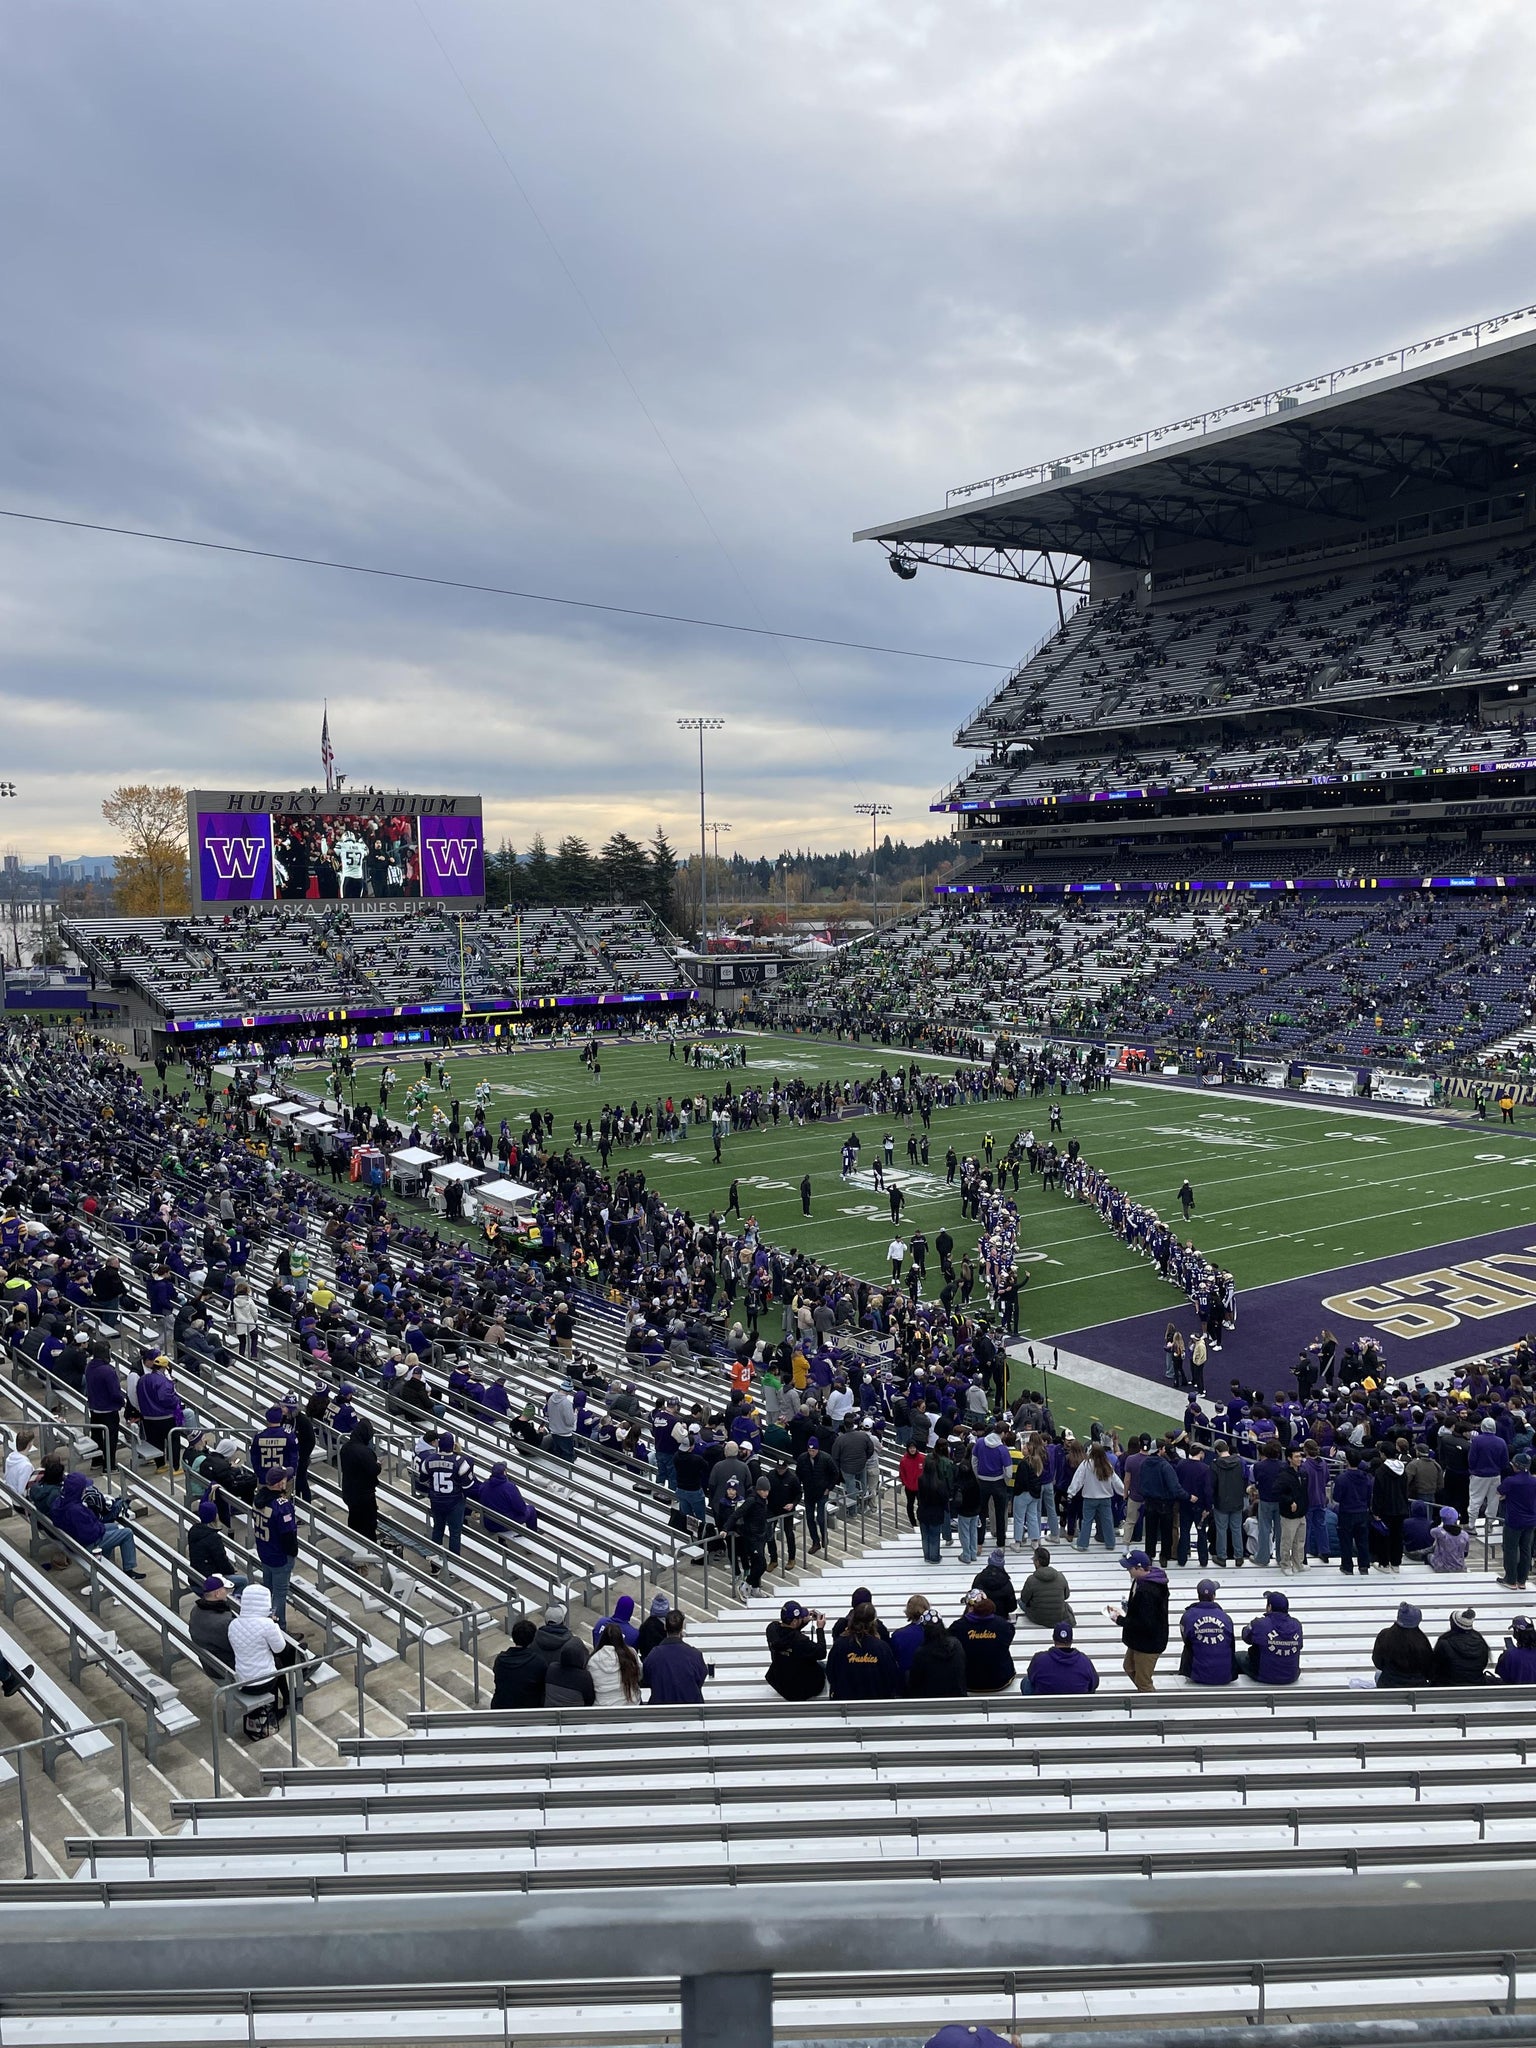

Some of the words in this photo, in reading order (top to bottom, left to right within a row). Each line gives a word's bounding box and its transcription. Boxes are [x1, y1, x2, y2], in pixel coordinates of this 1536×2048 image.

[1495, 761, 1526, 770] WOMEN'S
[226, 794, 324, 812] HUSKY
[338, 797, 456, 814] STADIUM
[1444, 802, 1508, 816] NATIONAL
[205, 838, 265, 878] W
[345, 851, 362, 866] 57
[426, 838, 477, 877] W
[1451, 878, 1476, 886] facebook
[248, 904, 315, 916] ALASKA
[324, 903, 397, 915] AIRLINES
[403, 902, 447, 914] FIELD
[440, 975, 483, 989] Allstate
[740, 967, 759, 983] W
[195, 1020, 222, 1029] facebook
[830, 1336, 840, 1347] W
[878, 1341, 888, 1352] W
[260, 1447, 284, 1468] 25
[432, 1471, 454, 1494] 15
[1193, 1616, 1225, 1630] ALUMNI
[967, 1629, 997, 1640] Huskies
[1197, 1633, 1225, 1645] BAND
[1268, 1645, 1298, 1656] BAND
[847, 1652, 878, 1664] Huskies
